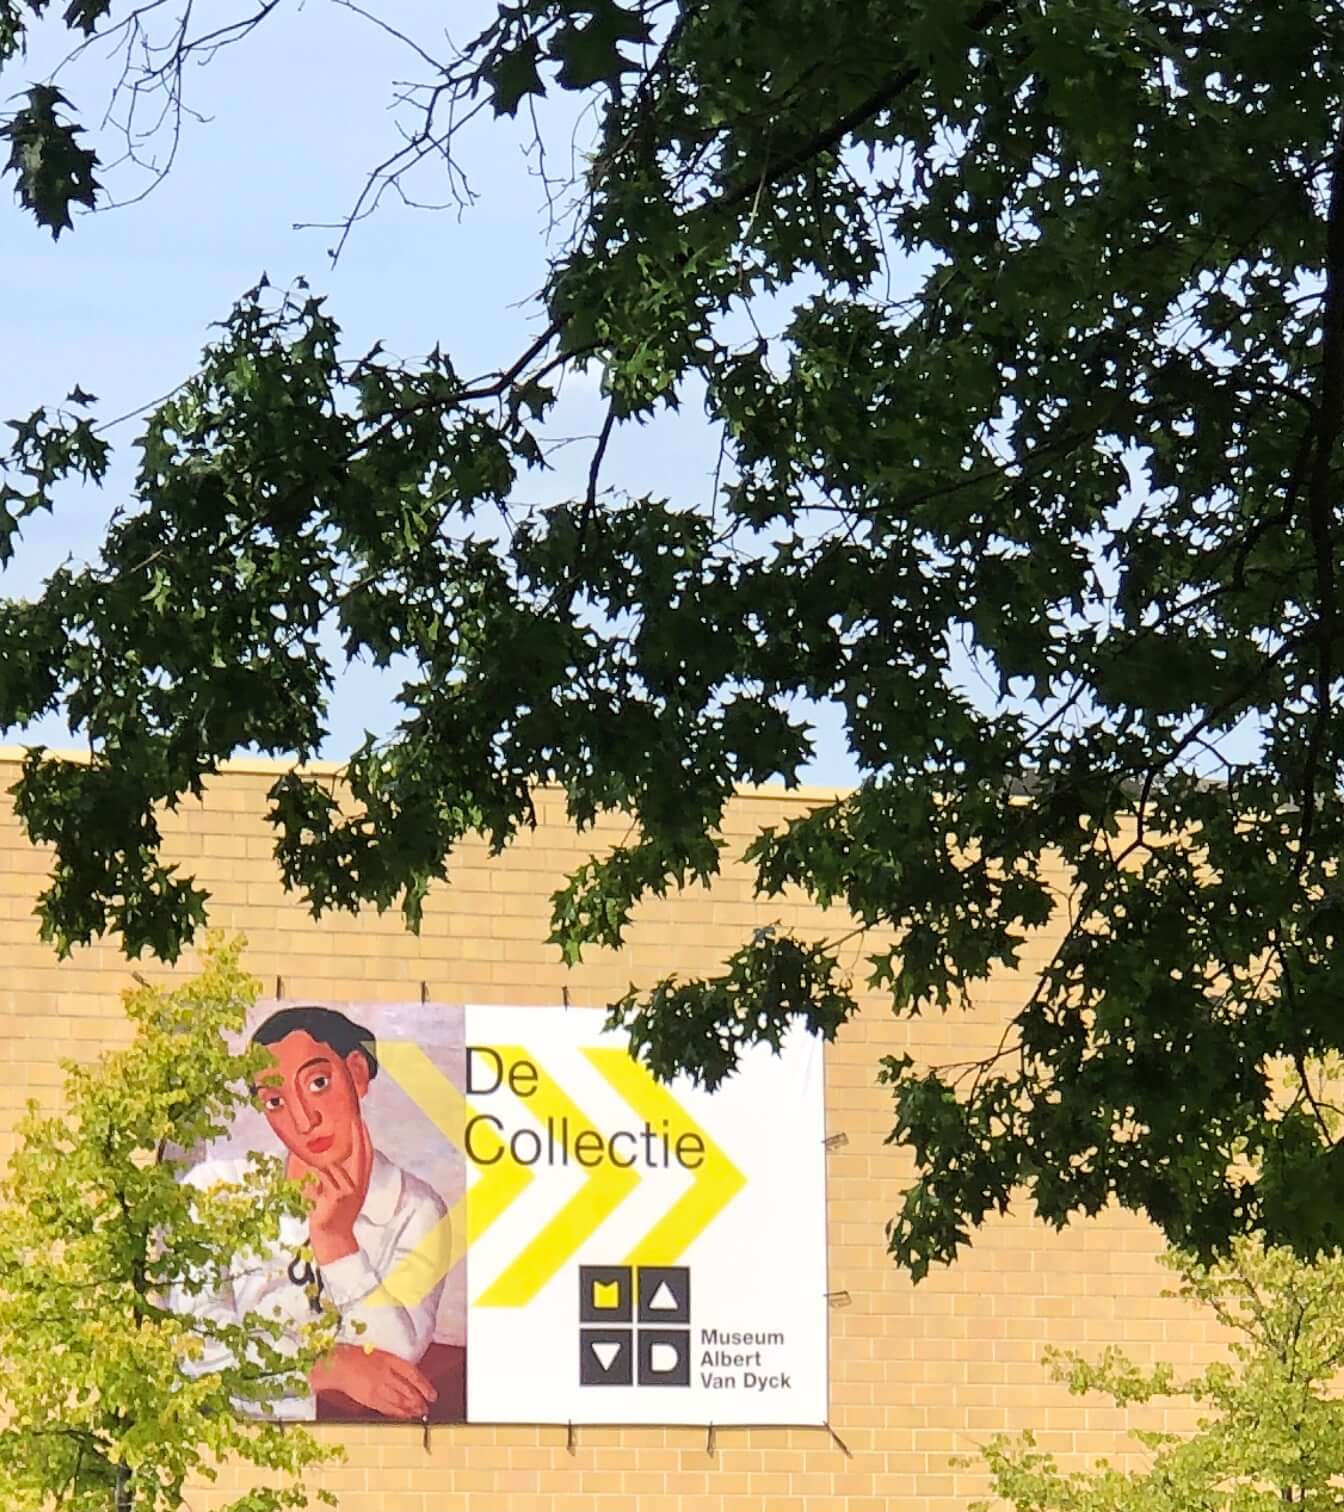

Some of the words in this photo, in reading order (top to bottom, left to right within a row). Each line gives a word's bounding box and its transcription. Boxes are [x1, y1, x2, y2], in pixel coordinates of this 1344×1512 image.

[465, 1046, 538, 1098] De
[464, 1113, 705, 1169] Collectie
[700, 1328, 785, 1346] Museum
[700, 1350, 762, 1368] Albert
[700, 1372, 736, 1389] Van
[743, 1372, 792, 1393] Dyck
